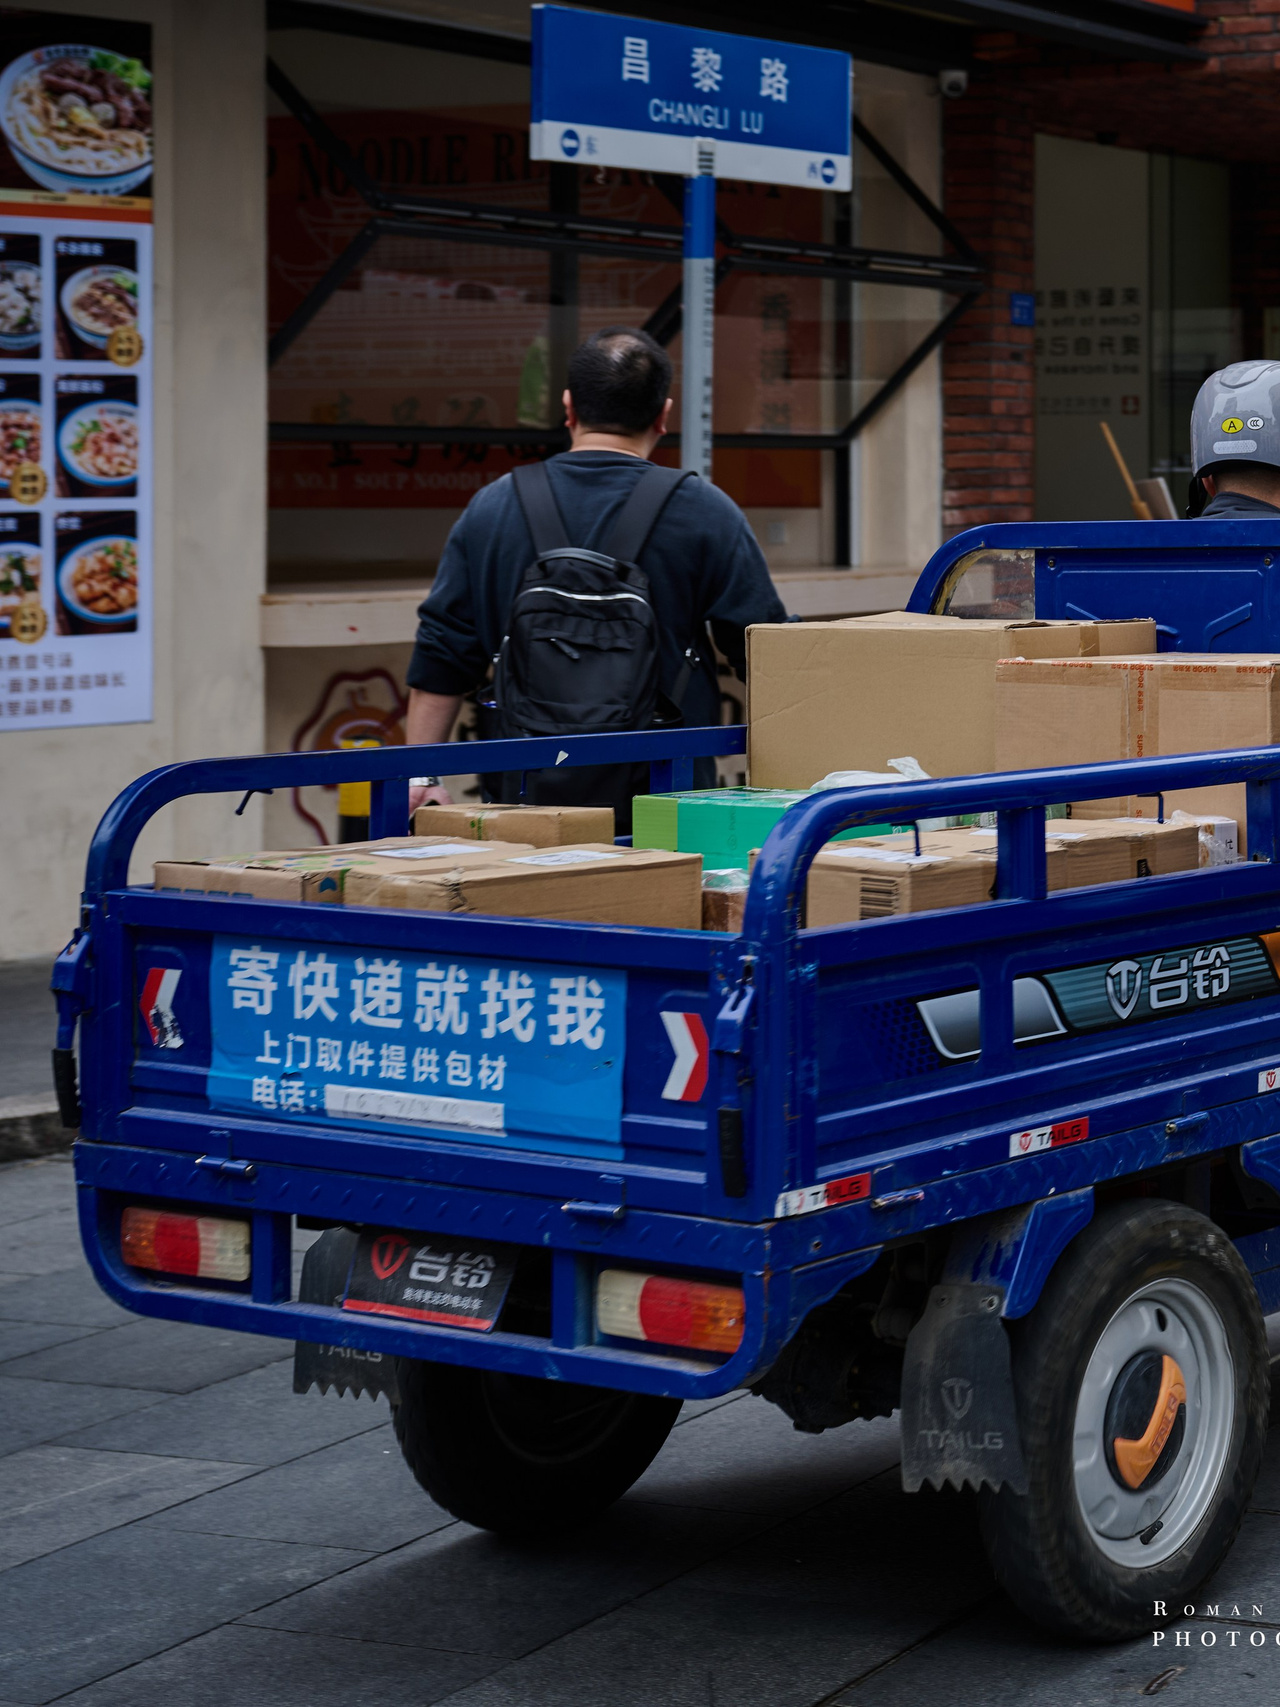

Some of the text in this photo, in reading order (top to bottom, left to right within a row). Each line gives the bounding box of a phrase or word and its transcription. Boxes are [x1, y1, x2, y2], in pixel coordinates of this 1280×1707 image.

[621, 35, 790, 103] 昌黎路
[648, 98, 764, 135] CHANGLI LU
[1227, 421, 1238, 431] A
[1192, 665, 1217, 674] SUPOR
[1149, 944, 1231, 1011] 台铃
[227, 944, 606, 1051] 寄快递就找我
[255, 1029, 508, 1092] 上门取件提供包材
[1037, 1123, 1083, 1148] TAILG
[811, 1179, 861, 1208] TAILG
[408, 1244, 497, 1289] 台铃
[917, 1430, 1005, 1450] TAILG
